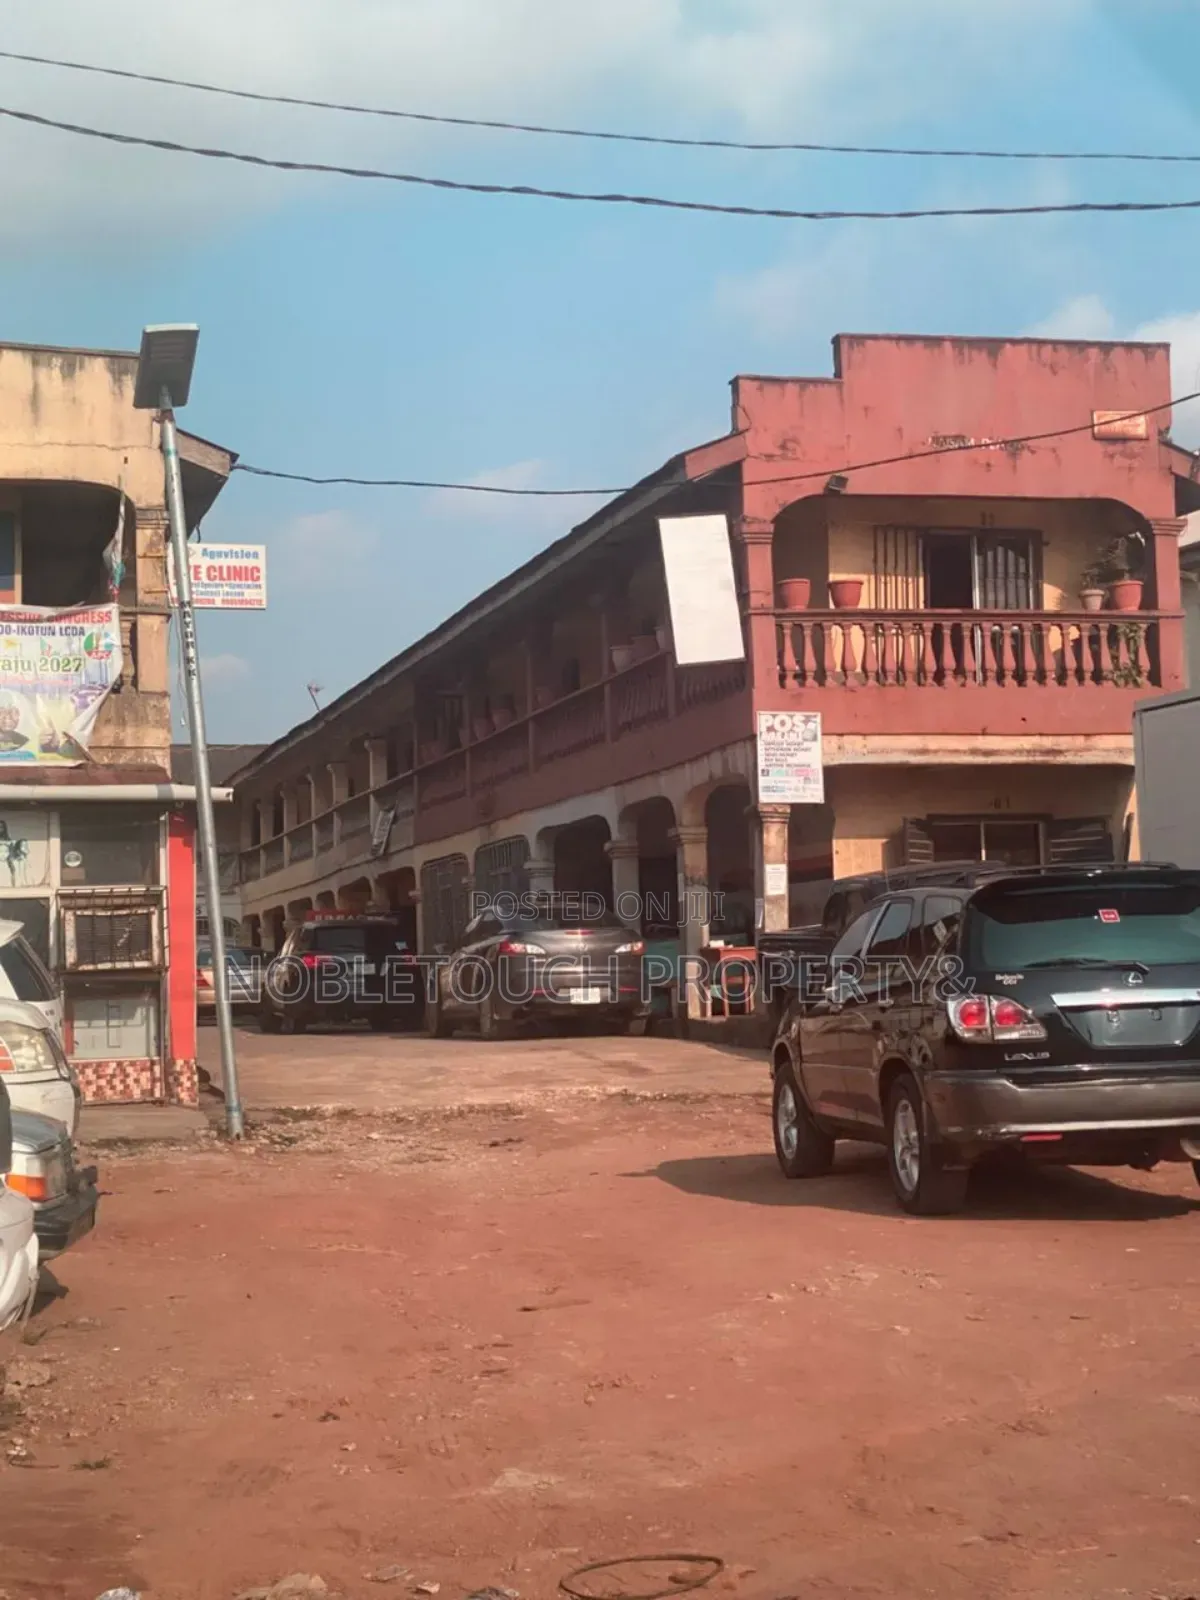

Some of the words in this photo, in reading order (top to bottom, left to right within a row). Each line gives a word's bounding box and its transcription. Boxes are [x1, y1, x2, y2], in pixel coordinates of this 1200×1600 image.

[206, 565, 261, 582] CLINIC
[60, 627, 85, 637] LCDA
[39, 658, 82, 673] 2027
[759, 714, 806, 733] POS
[1003, 1052, 1050, 1061] LEXUS
